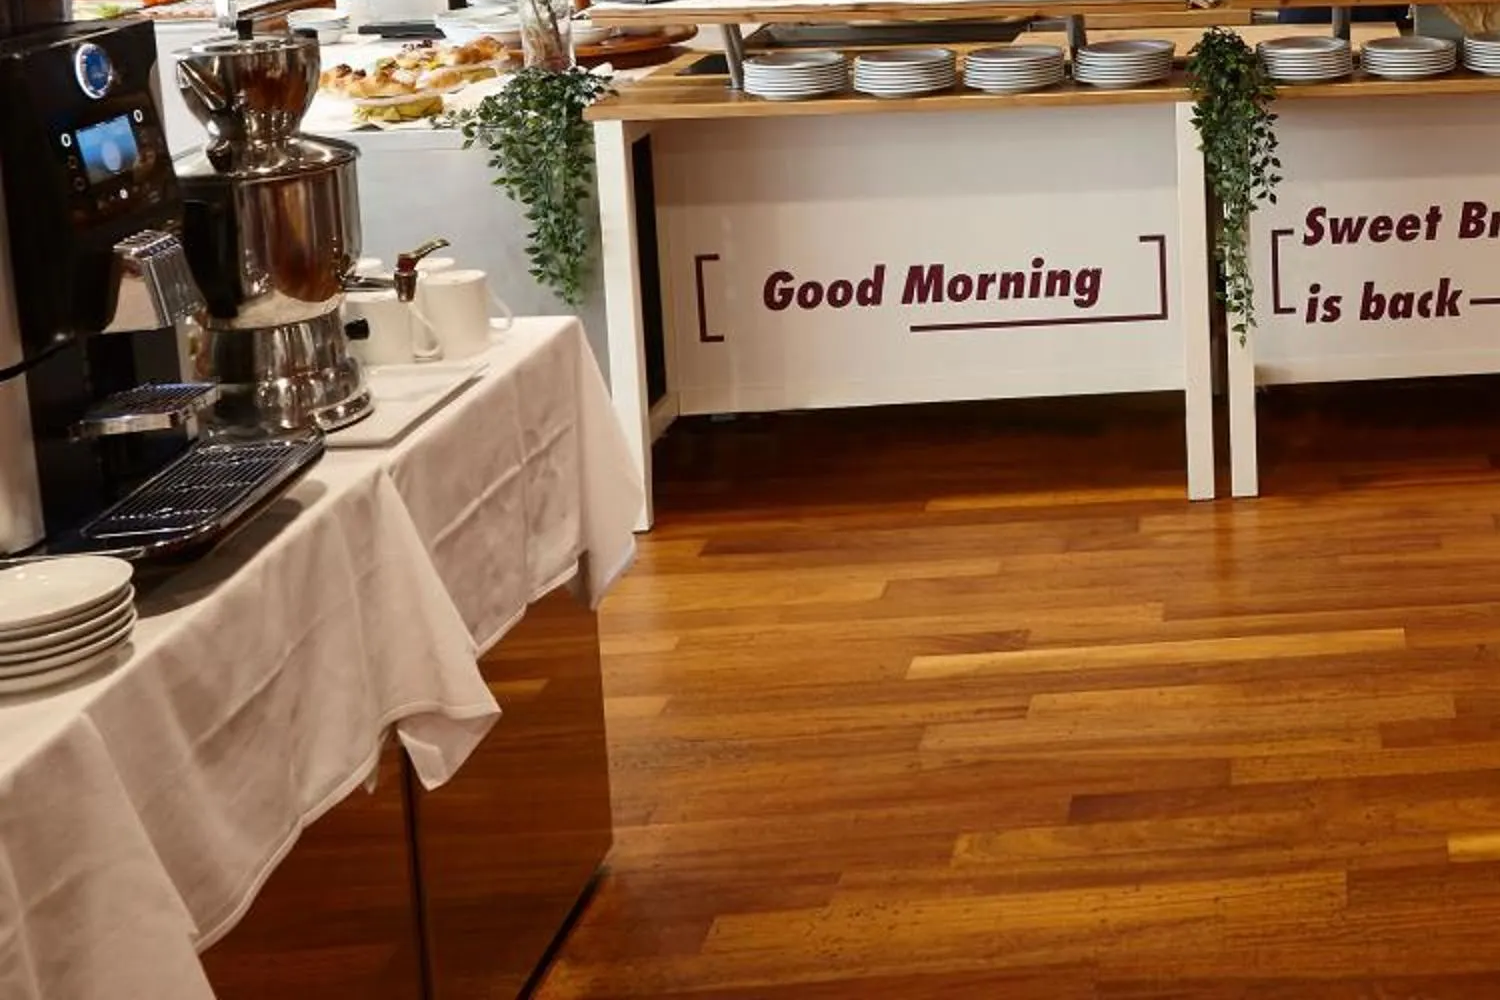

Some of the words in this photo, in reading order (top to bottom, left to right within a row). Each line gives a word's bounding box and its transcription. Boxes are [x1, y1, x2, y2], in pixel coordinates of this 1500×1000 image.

[1303, 205, 1442, 246] Sweet
[763, 263, 886, 311] Good
[901, 256, 1102, 309] Morning
[1305, 283, 1342, 323] is
[1359, 277, 1463, 321] back
